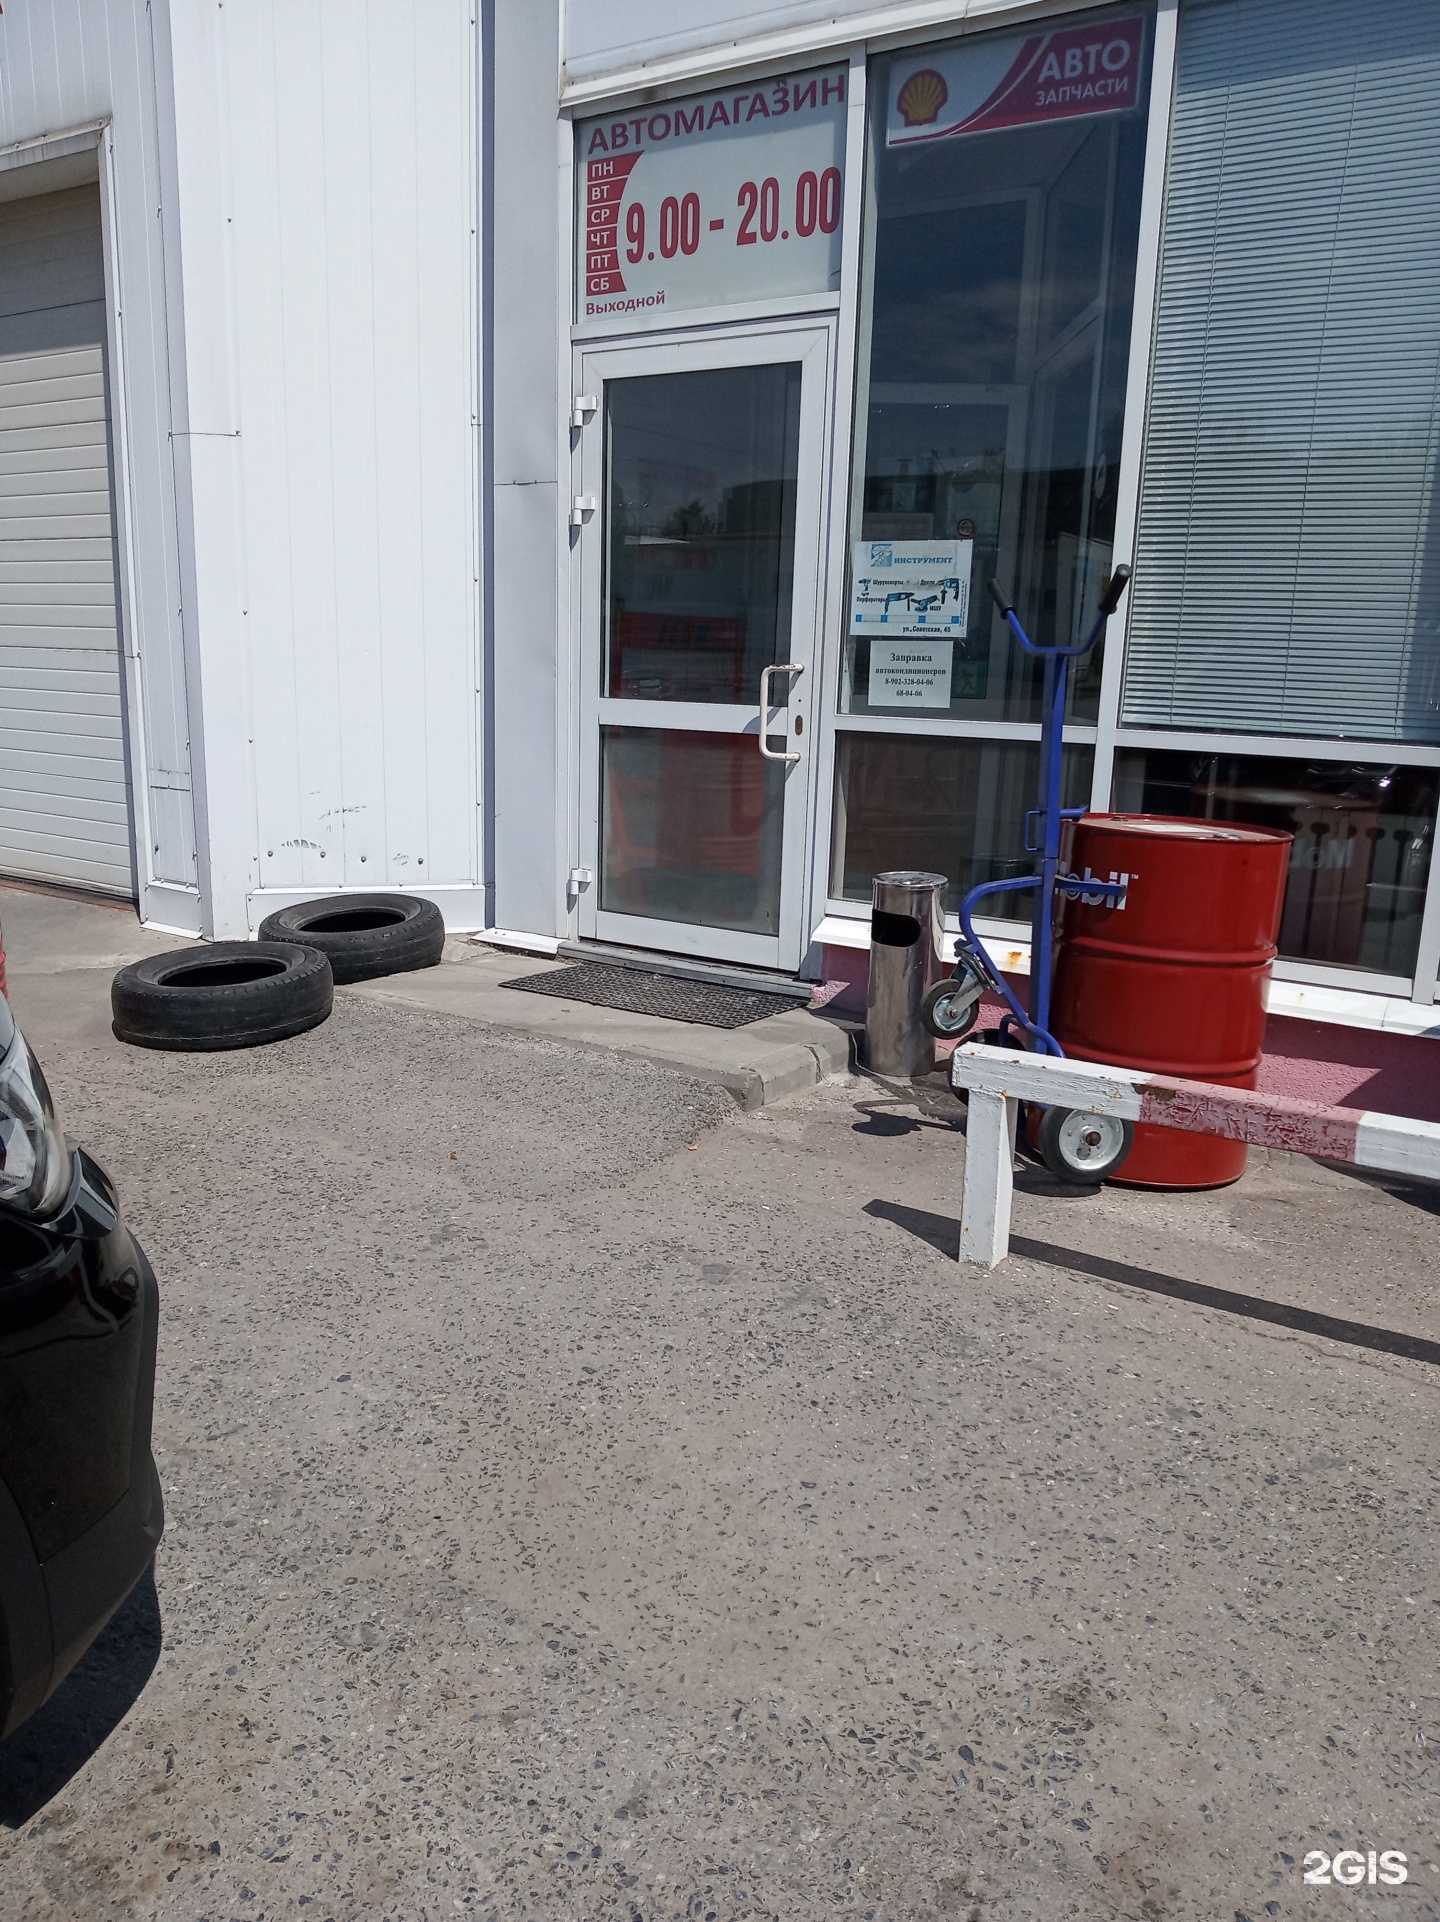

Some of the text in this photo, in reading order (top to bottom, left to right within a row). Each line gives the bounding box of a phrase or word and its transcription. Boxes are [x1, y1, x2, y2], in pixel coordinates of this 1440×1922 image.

[1038, 40, 1131, 82] АВТО
[1035, 77, 1129, 107] ЗАПЧАСТИ
[588, 74, 845, 155] АВТОМАГАЗИН
[591, 161, 614, 178] ПН
[591, 185, 610, 201] ВТ
[591, 208, 610, 224] СР
[590, 231, 610, 247] ЧТ
[590, 254, 611, 270] ПТ
[590, 277, 610, 292] СБ
[586, 290, 665, 316] Выходной
[894, 556, 952, 565] ИНСТРУМЕНТ
[889, 652, 932, 664] Заправка
[875, 668, 946, 676] автокондиционеров
